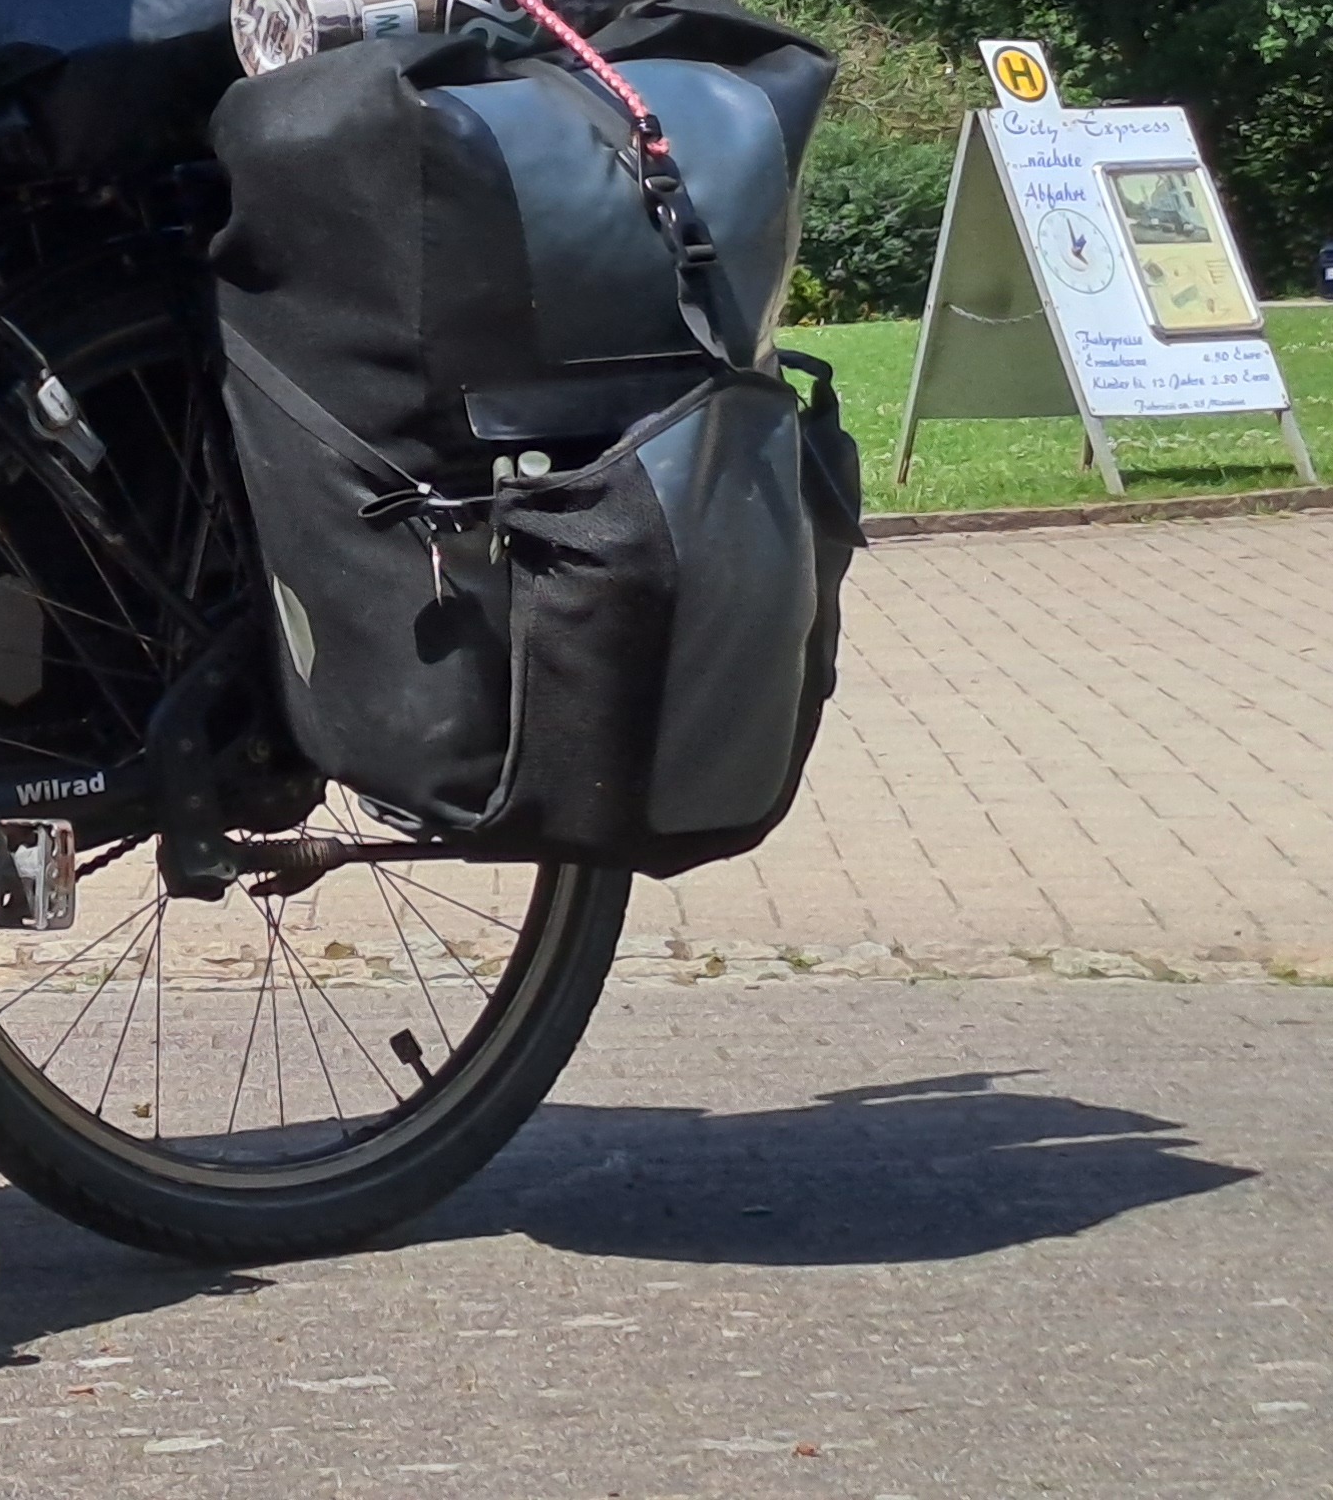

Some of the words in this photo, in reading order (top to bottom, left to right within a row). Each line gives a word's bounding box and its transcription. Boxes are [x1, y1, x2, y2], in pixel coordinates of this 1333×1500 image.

[1002, 56, 1038, 92] H
[1003, 110, 1058, 143] City
[1077, 111, 1171, 143] Express
[15, 771, 106, 807] Wilrad
